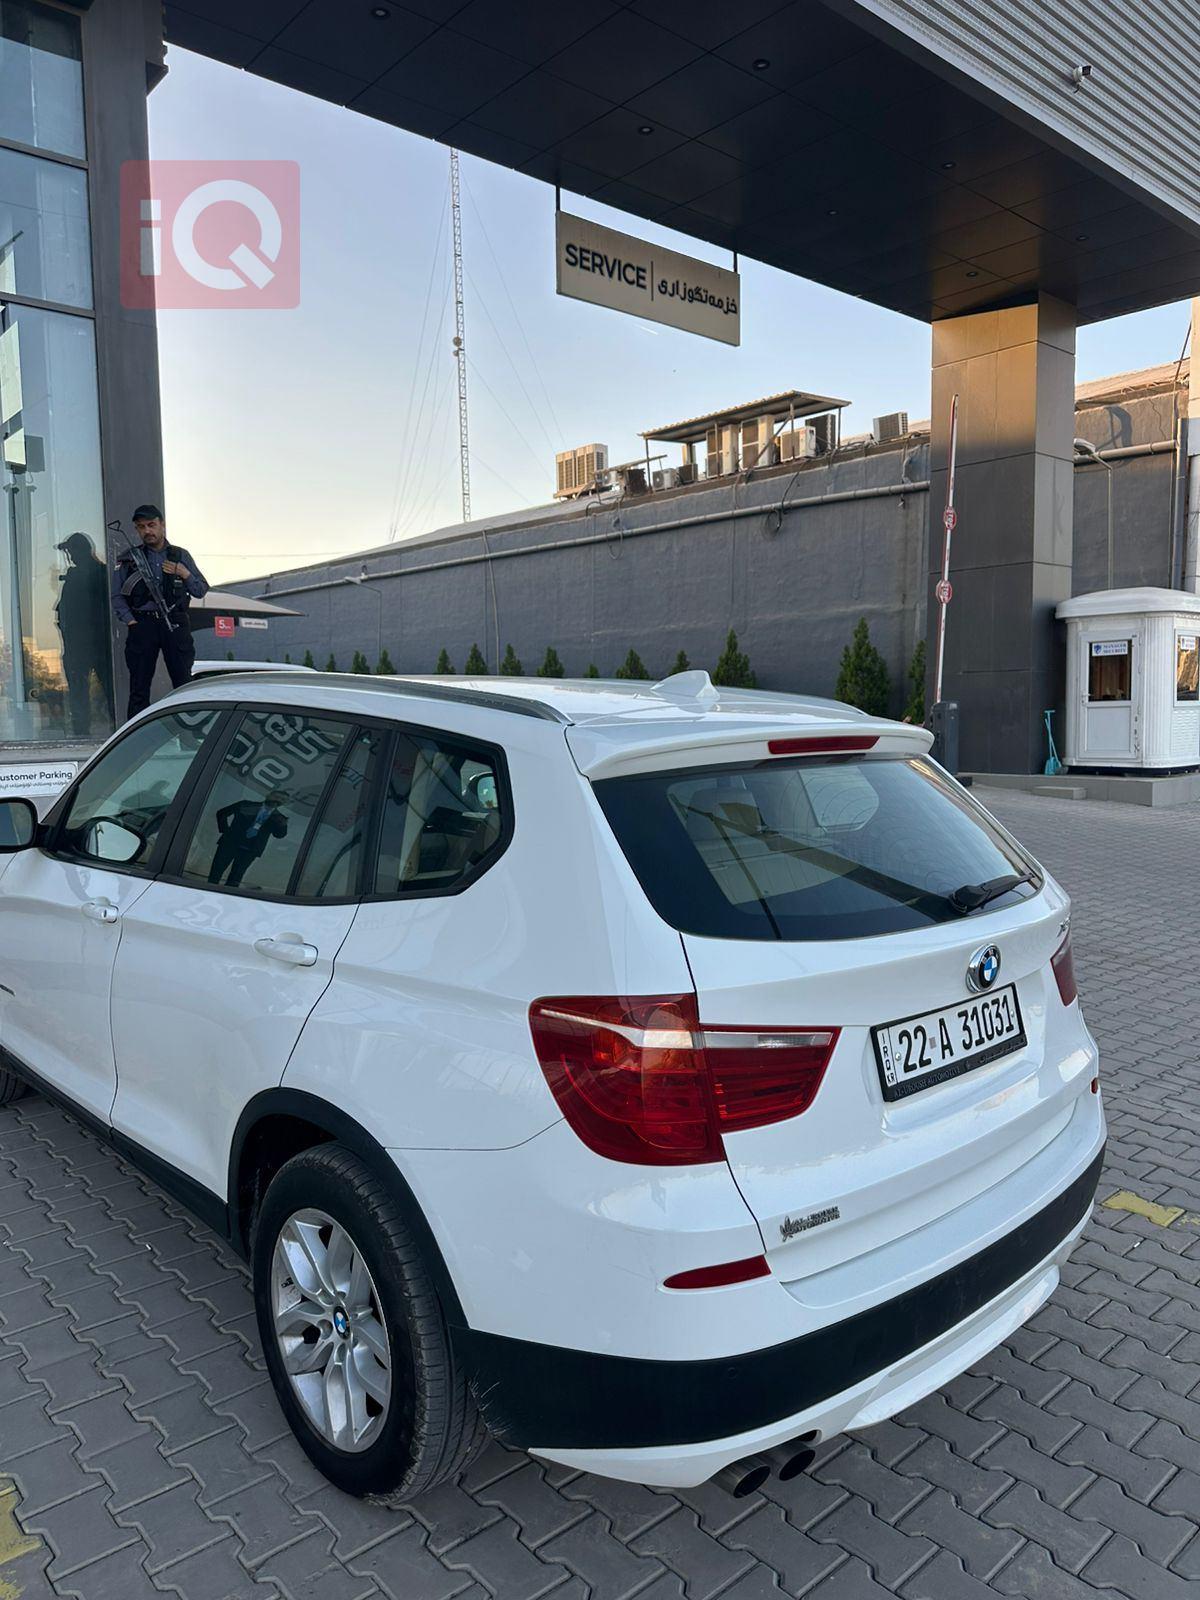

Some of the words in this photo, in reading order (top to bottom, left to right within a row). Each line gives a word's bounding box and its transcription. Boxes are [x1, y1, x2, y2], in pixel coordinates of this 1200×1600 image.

[565, 243, 647, 289] SERVICE
[0, 773, 37, 781] ustomer
[40, 771, 73, 780] Parking
[898, 1025, 932, 1073] 22
[938, 1017, 954, 1060] A
[957, 995, 1015, 1050] 31031
